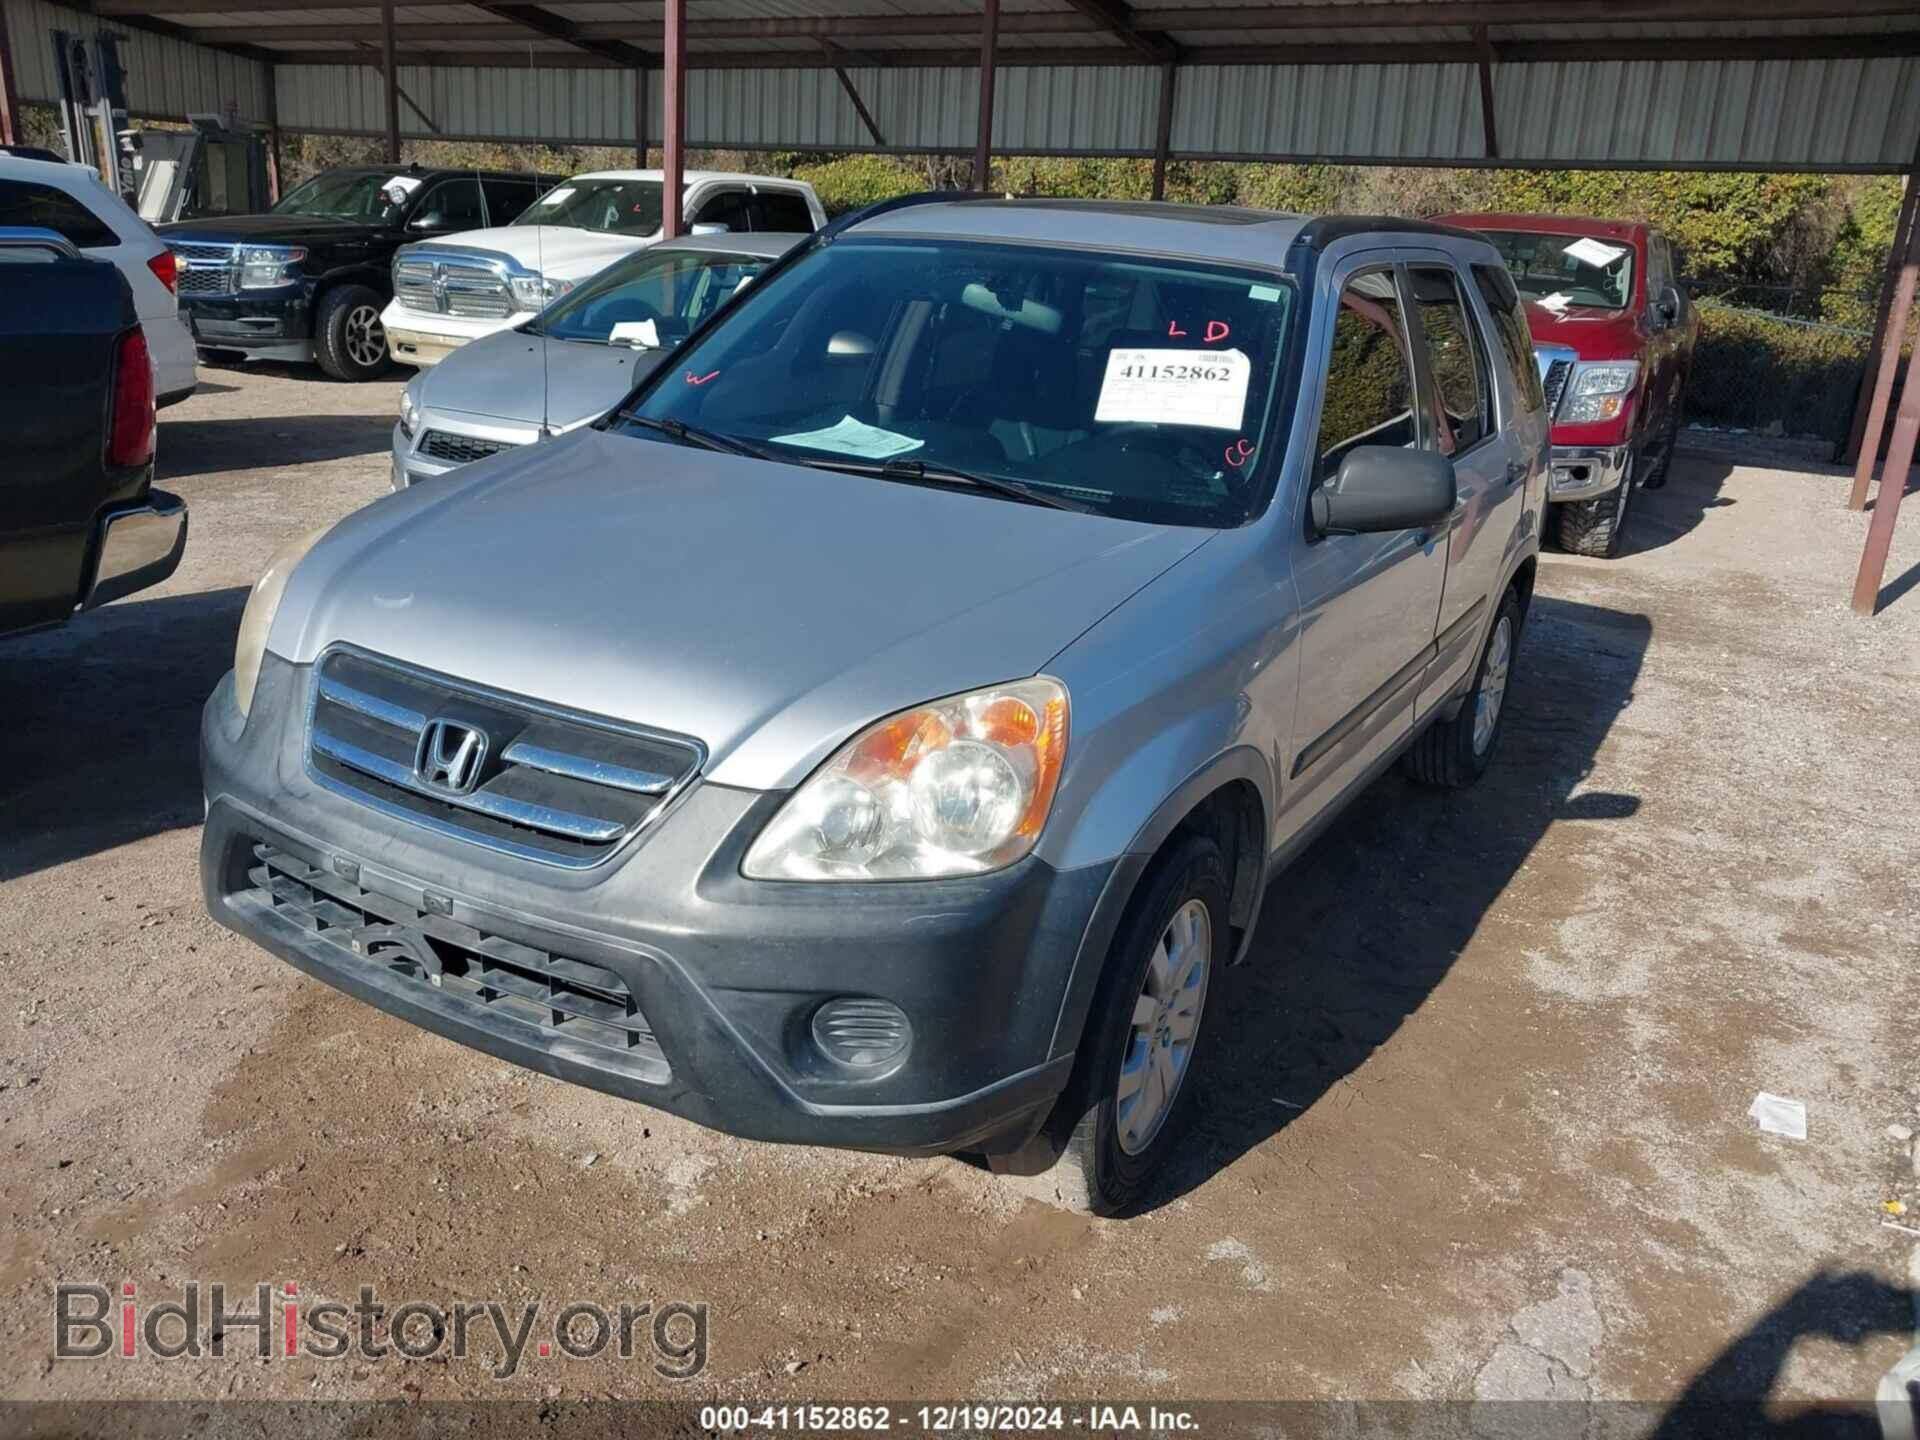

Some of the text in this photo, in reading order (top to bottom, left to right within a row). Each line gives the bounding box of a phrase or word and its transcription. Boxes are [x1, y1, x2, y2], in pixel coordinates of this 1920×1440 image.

[120, 156, 134, 194] Yale
[1203, 320, 1230, 342] D
[1119, 364, 1231, 382] 41152862
